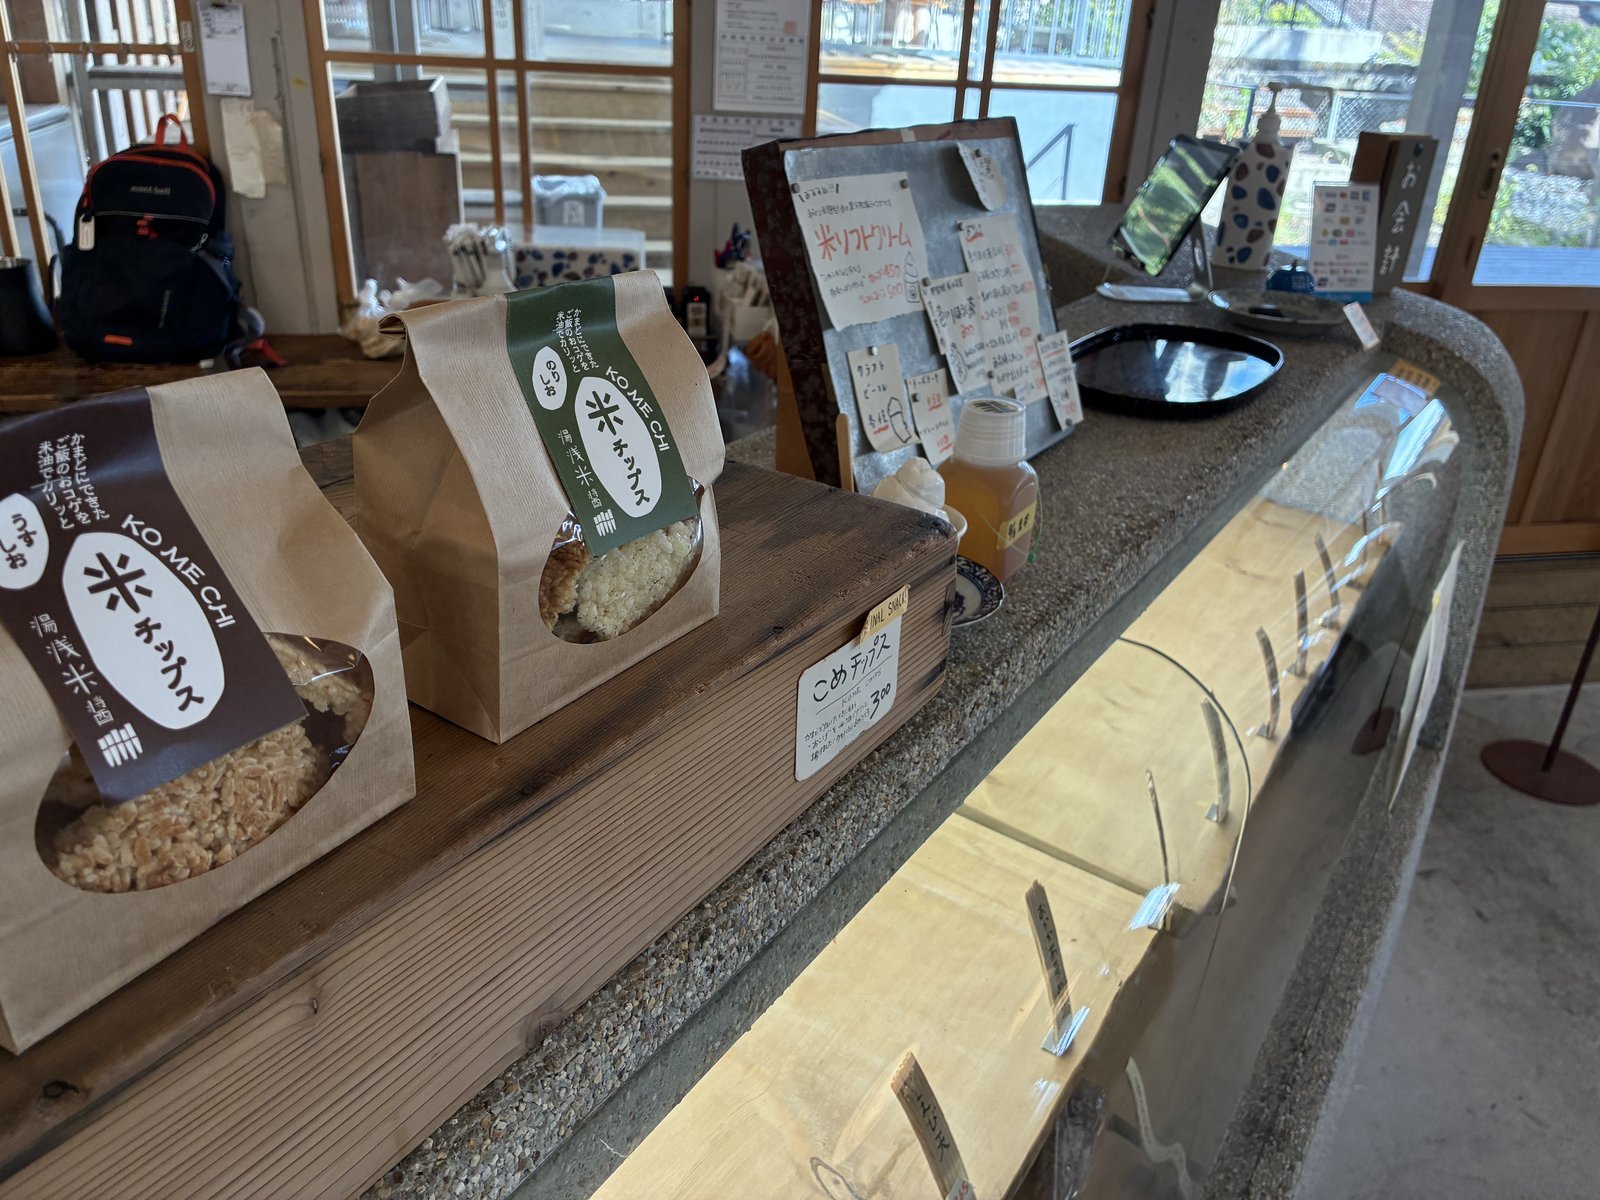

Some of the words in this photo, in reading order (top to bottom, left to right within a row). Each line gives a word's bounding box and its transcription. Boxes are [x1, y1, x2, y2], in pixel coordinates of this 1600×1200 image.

[37, 440, 75, 529] 米油でカリッと
[54, 434, 91, 524] ご飯のおコゲを
[70, 433, 110, 520] かまどにできた
[870, 683, 891, 719] 300
